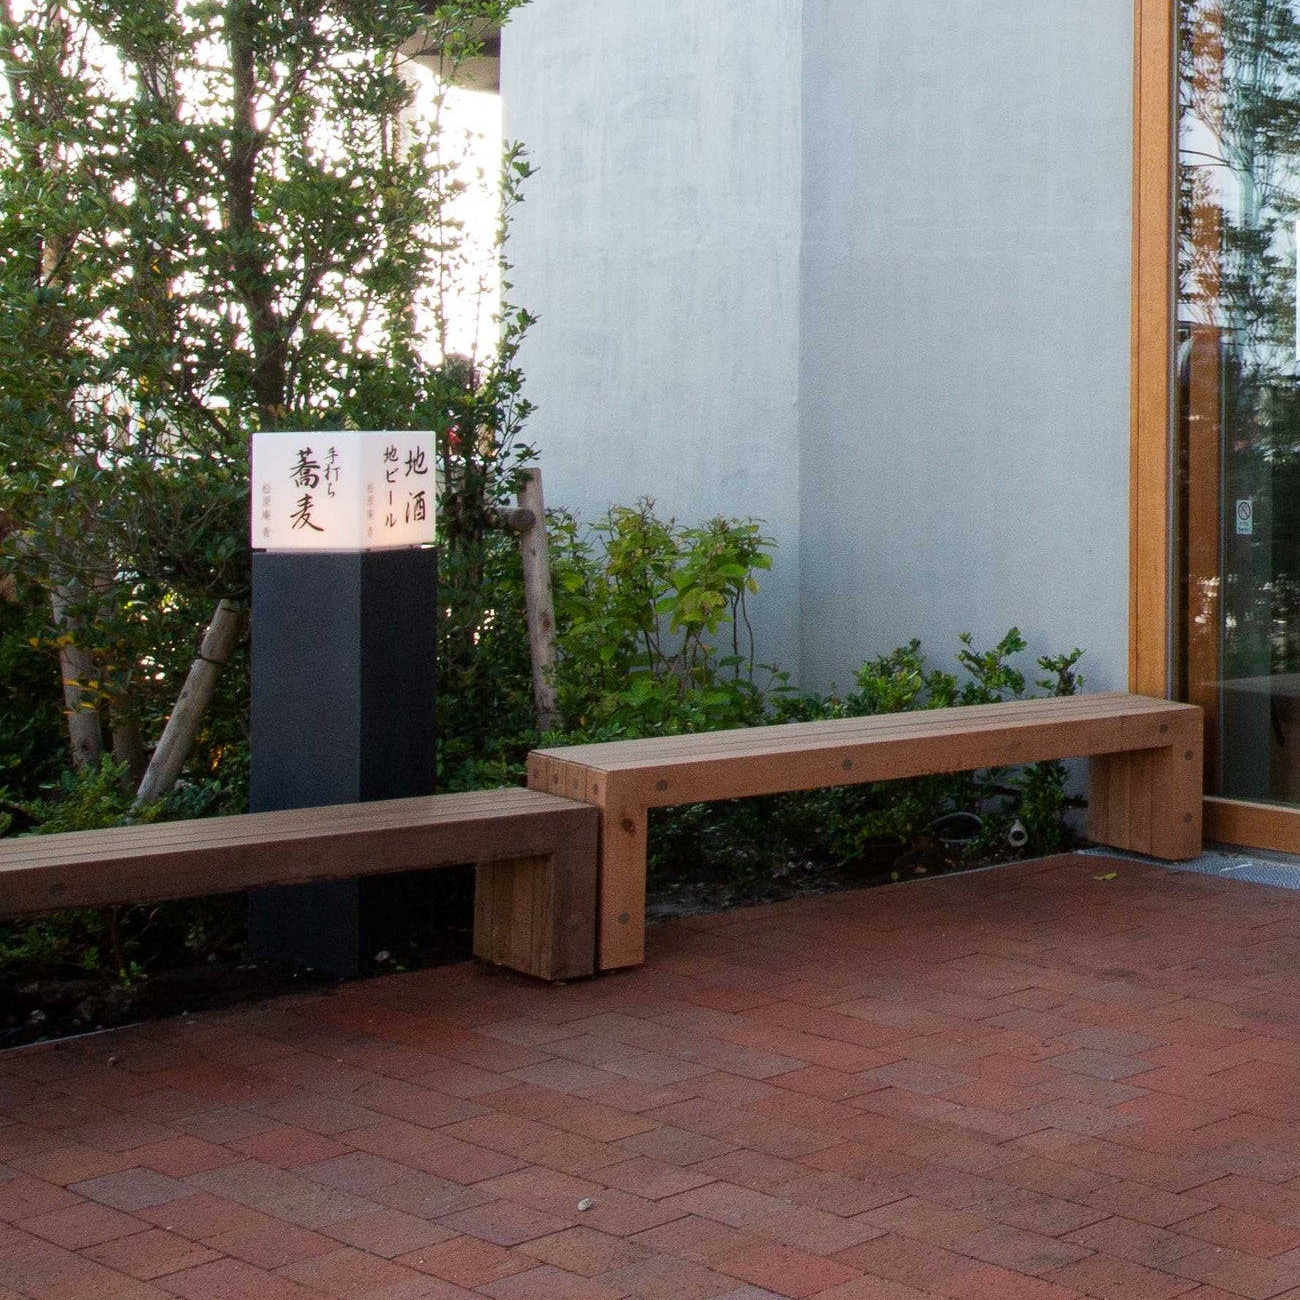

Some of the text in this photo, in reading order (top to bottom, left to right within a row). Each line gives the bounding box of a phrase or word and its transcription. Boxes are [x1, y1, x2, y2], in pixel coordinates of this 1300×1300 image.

[289, 446, 325, 533] 蕎麦
[383, 444, 400, 528] 地ビール
[404, 445, 428, 525] 地酒
